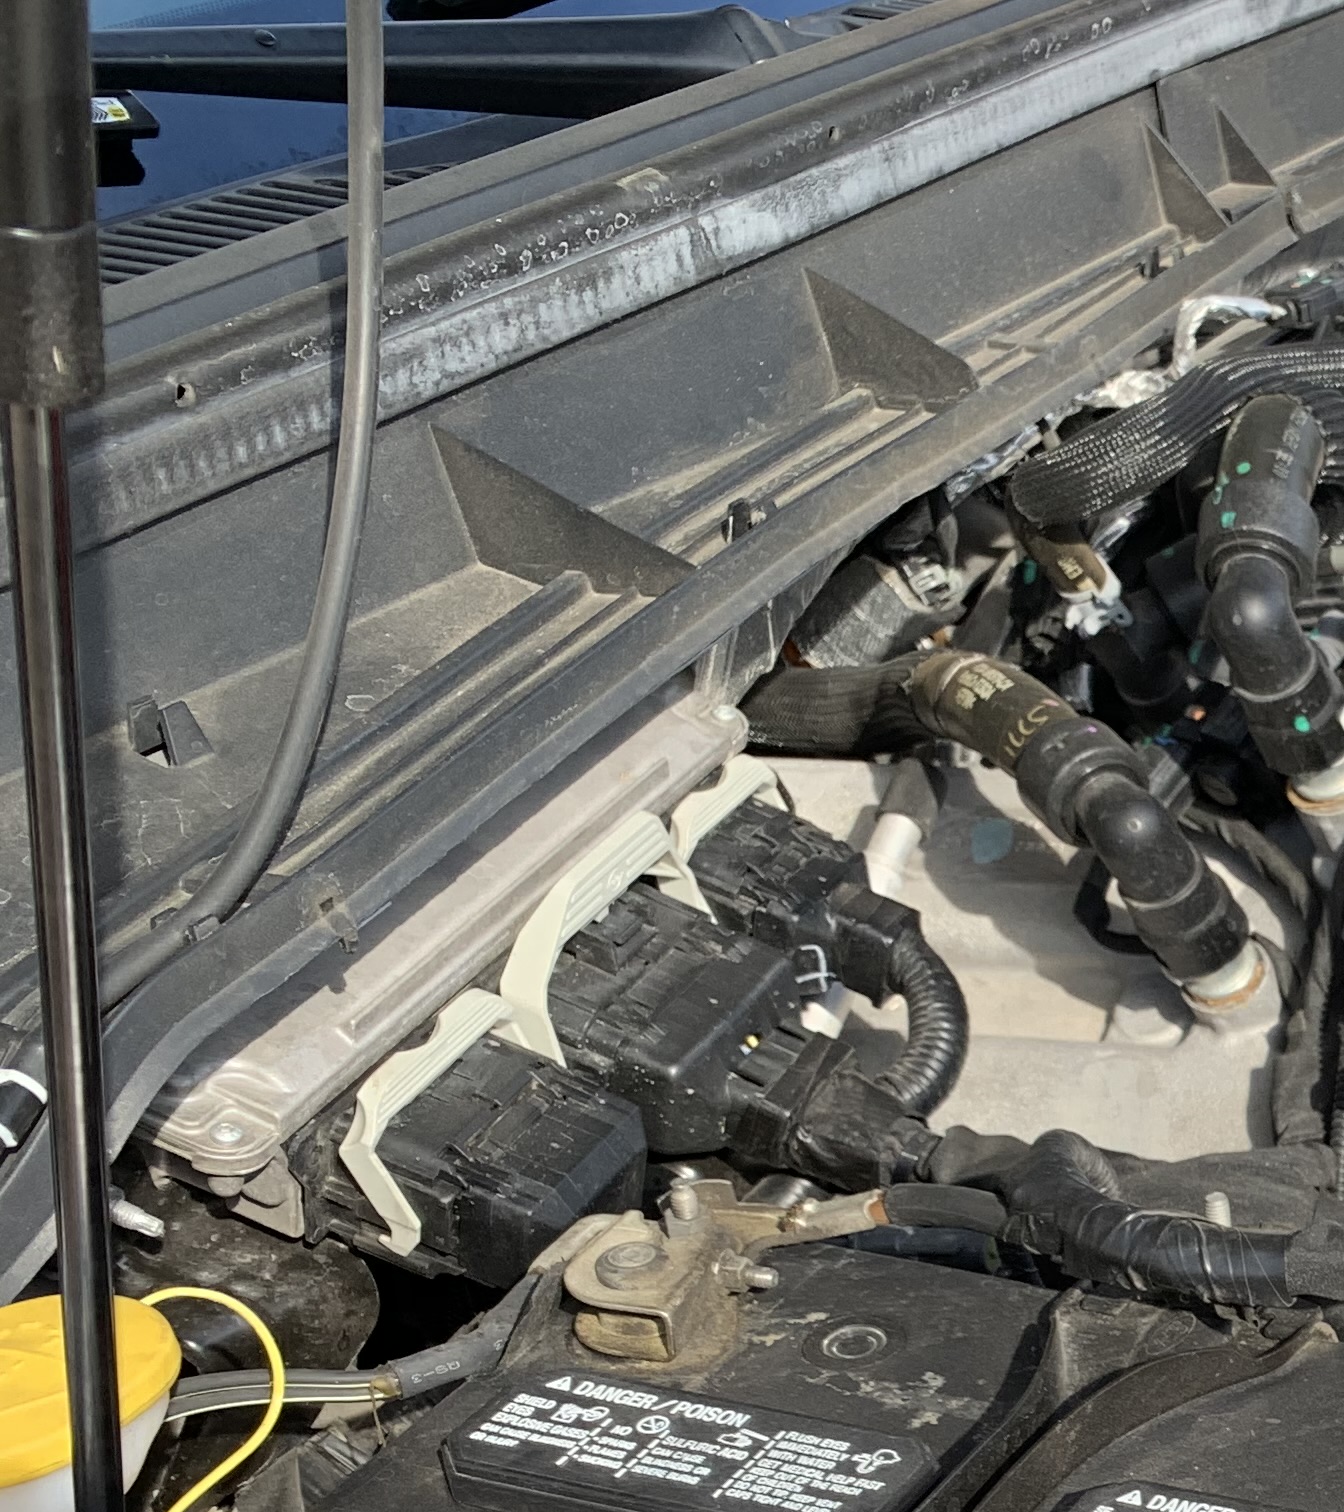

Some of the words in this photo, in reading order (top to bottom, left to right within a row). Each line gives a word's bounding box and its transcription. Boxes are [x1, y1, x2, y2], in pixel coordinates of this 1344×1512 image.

[512, 1392, 556, 1409] SHIELD
[572, 1380, 658, 1409] DANGER
[669, 1400, 751, 1427] POISON
[609, 1424, 632, 1435] NO
[660, 1435, 721, 1454] SULFURIC
[716, 1446, 749, 1460] ACID
